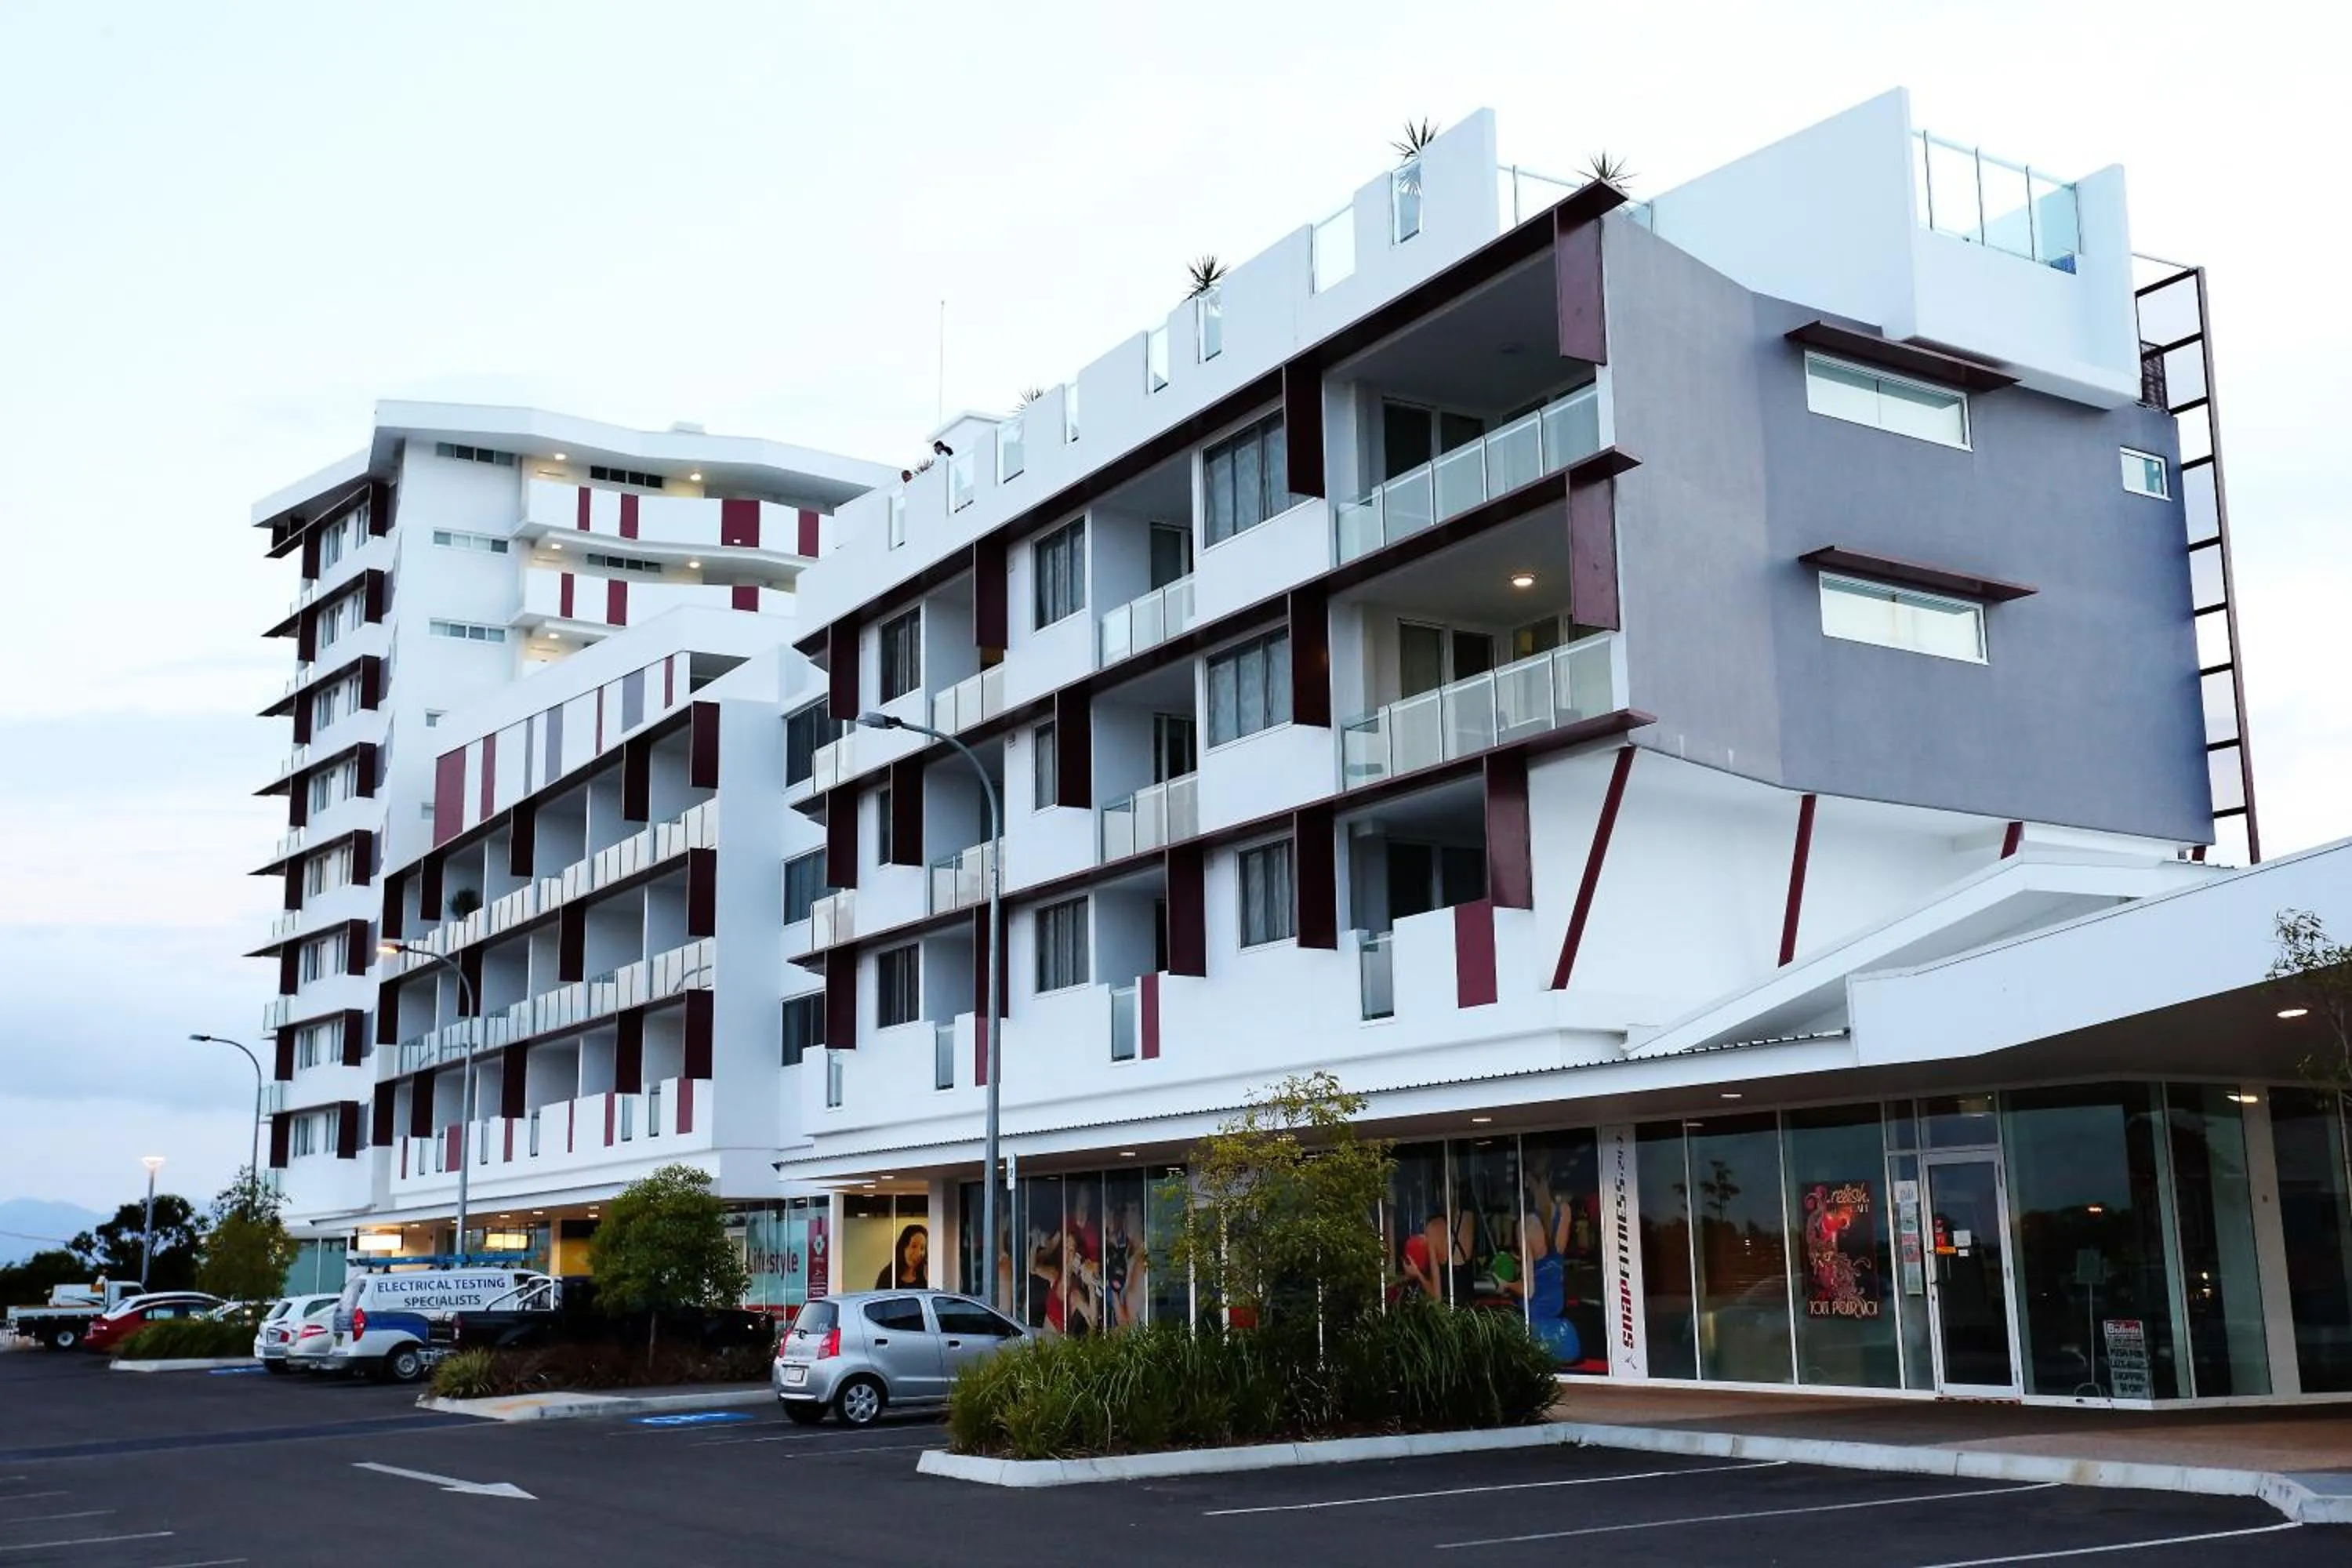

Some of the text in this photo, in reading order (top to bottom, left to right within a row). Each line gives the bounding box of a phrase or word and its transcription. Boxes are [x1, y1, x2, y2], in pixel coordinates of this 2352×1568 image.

[377, 1277, 506, 1292] ELECTRICAL TESTING
[404, 1294, 481, 1307] SPECIALISTS
